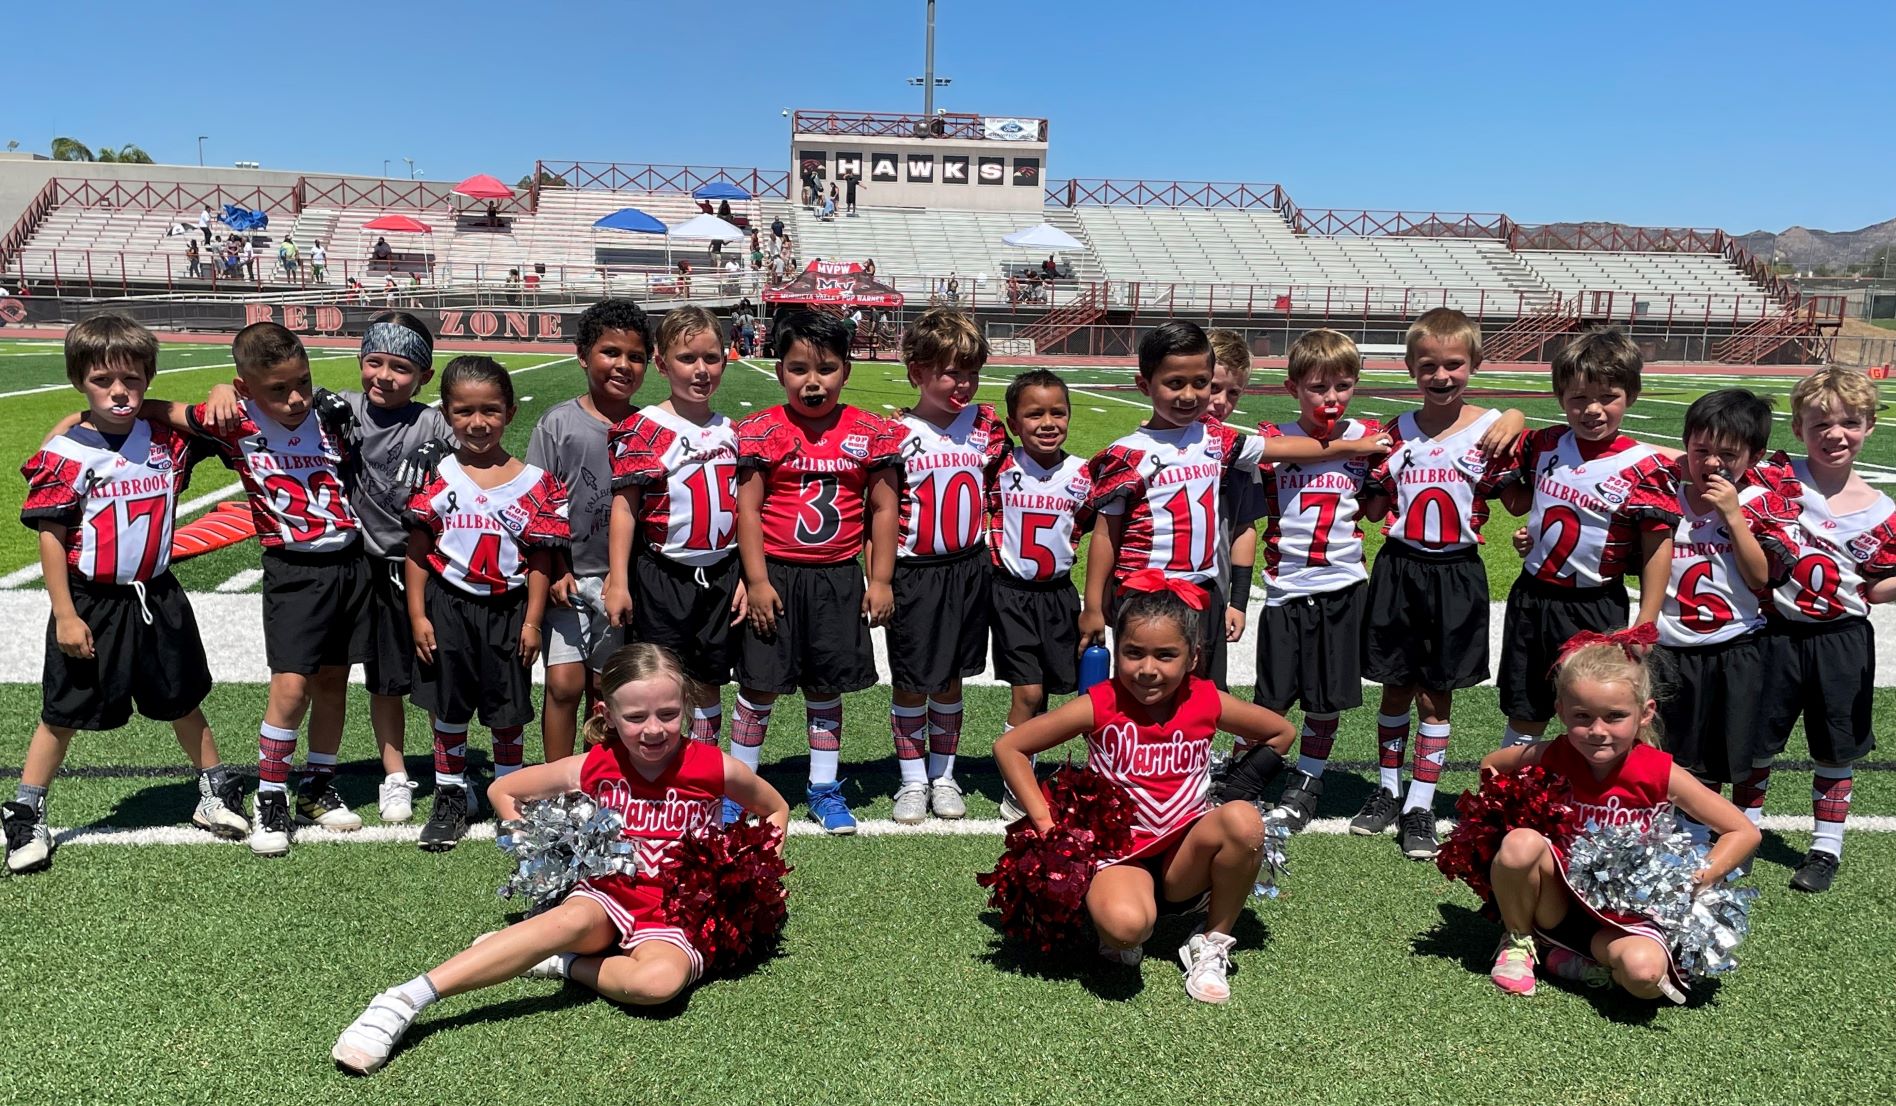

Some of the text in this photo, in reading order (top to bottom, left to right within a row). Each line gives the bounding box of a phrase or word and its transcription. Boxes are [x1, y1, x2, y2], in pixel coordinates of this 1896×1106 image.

[838, 159, 1003, 180] HAWKS
[817, 264, 850, 274] MVPW
[245, 303, 562, 338] RED ZONE
[842, 294, 856, 302] POP
[857, 295, 885, 303] WARNER
[1207, 438, 1221, 446] POP
[1429, 448, 1444, 457] AP
[1467, 449, 1484, 457] PO
[90, 474, 169, 498] ALLBROOK
[682, 464, 738, 551] 15
[1072, 477, 1090, 485] POP
[1606, 475, 1630, 489] POP
[508, 504, 528, 516] POP
[794, 472, 841, 546] 3
[912, 470, 982, 556] 10
[1162, 480, 1215, 572] 11
[1300, 491, 1341, 567] 7
[1404, 486, 1462, 550] 0
[89, 492, 167, 584] 17
[462, 532, 508, 596] 4
[1020, 511, 1057, 581] 5
[1535, 505, 1581, 588] 2
[1858, 533, 1878, 546] POP
[1676, 560, 1735, 635] 6
[1792, 553, 1847, 620] 8
[1102, 722, 1209, 776] Warriors
[597, 779, 712, 832] Warriors
